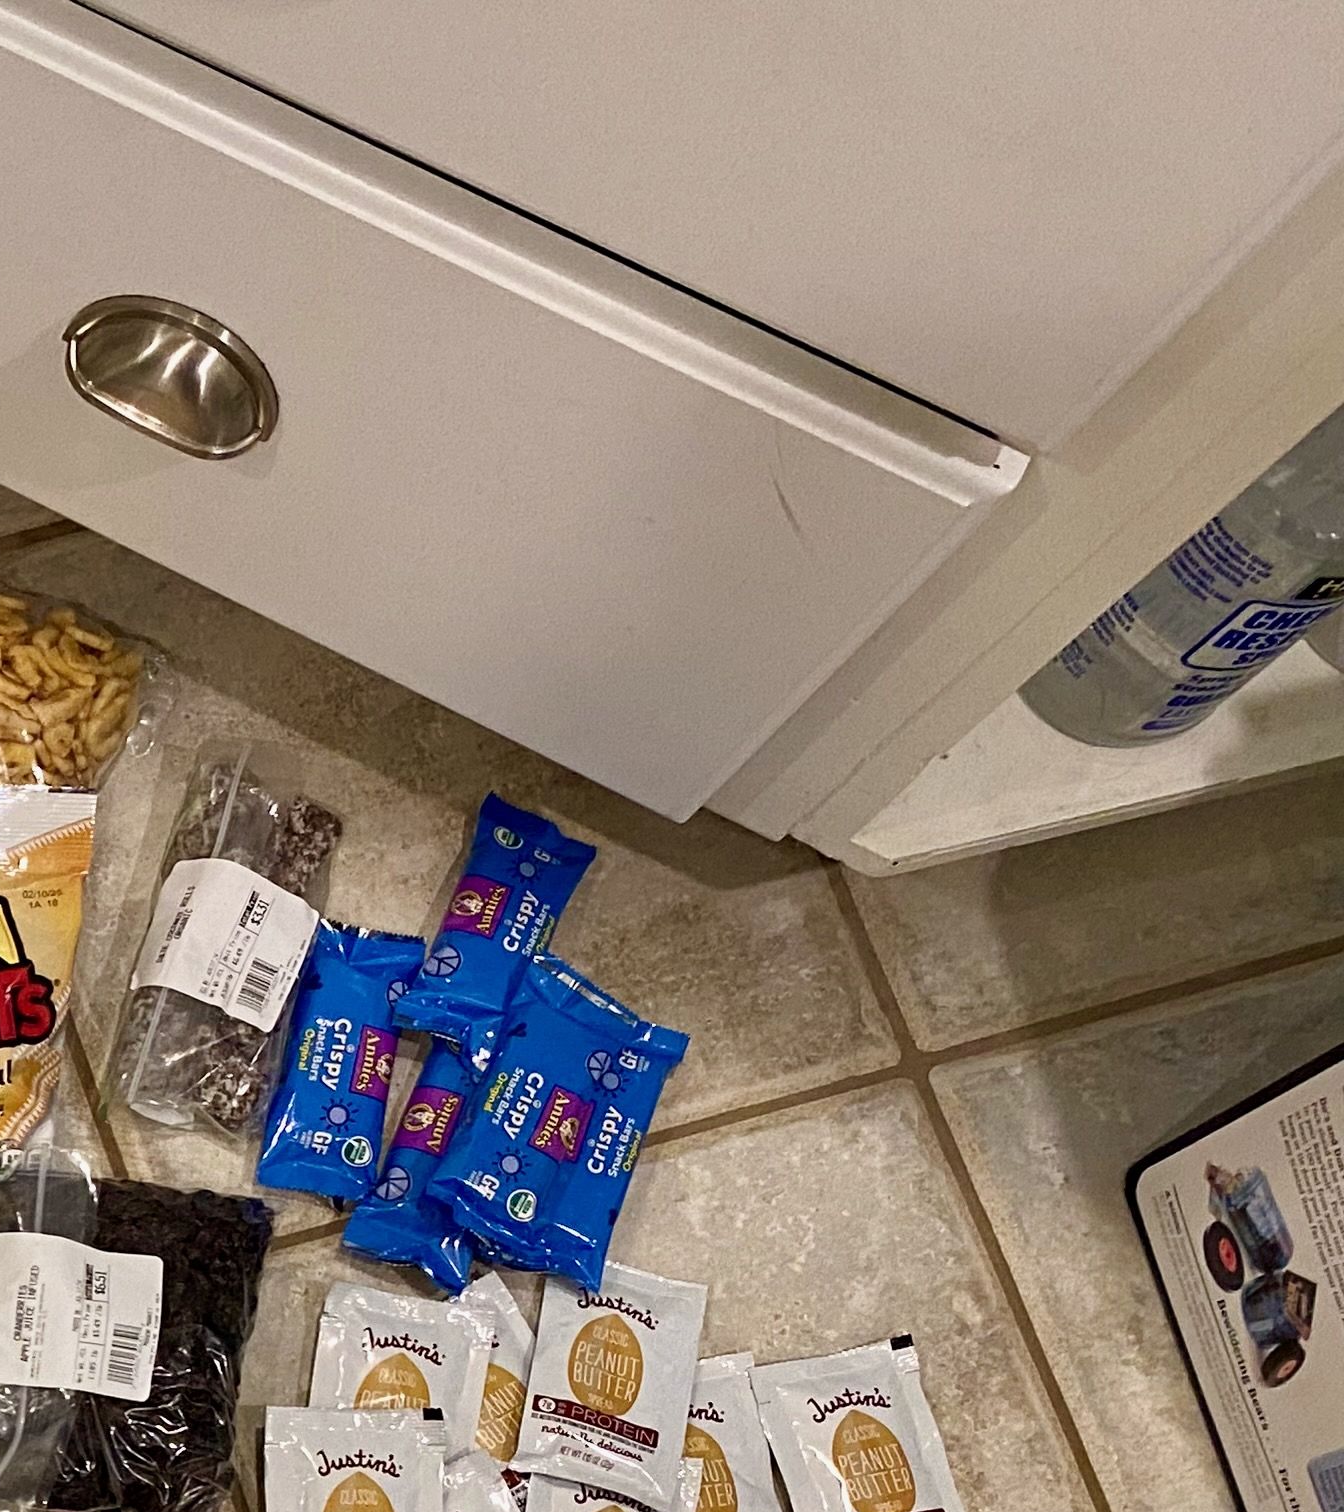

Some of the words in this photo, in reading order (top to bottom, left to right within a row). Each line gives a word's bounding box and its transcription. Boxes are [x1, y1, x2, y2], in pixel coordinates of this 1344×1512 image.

[502, 889, 540, 953] Crispy
[322, 1019, 352, 1091] Crispy
[312, 1131, 332, 1155] GF
[587, 1106, 623, 1175] Crispy
[620, 1117, 635, 1144] Bars
[622, 1130, 642, 1172] Original
[807, 1388, 891, 1422] Justin's
[317, 1449, 403, 1477] Justin's
[340, 1489, 378, 1505] CLASSIC
